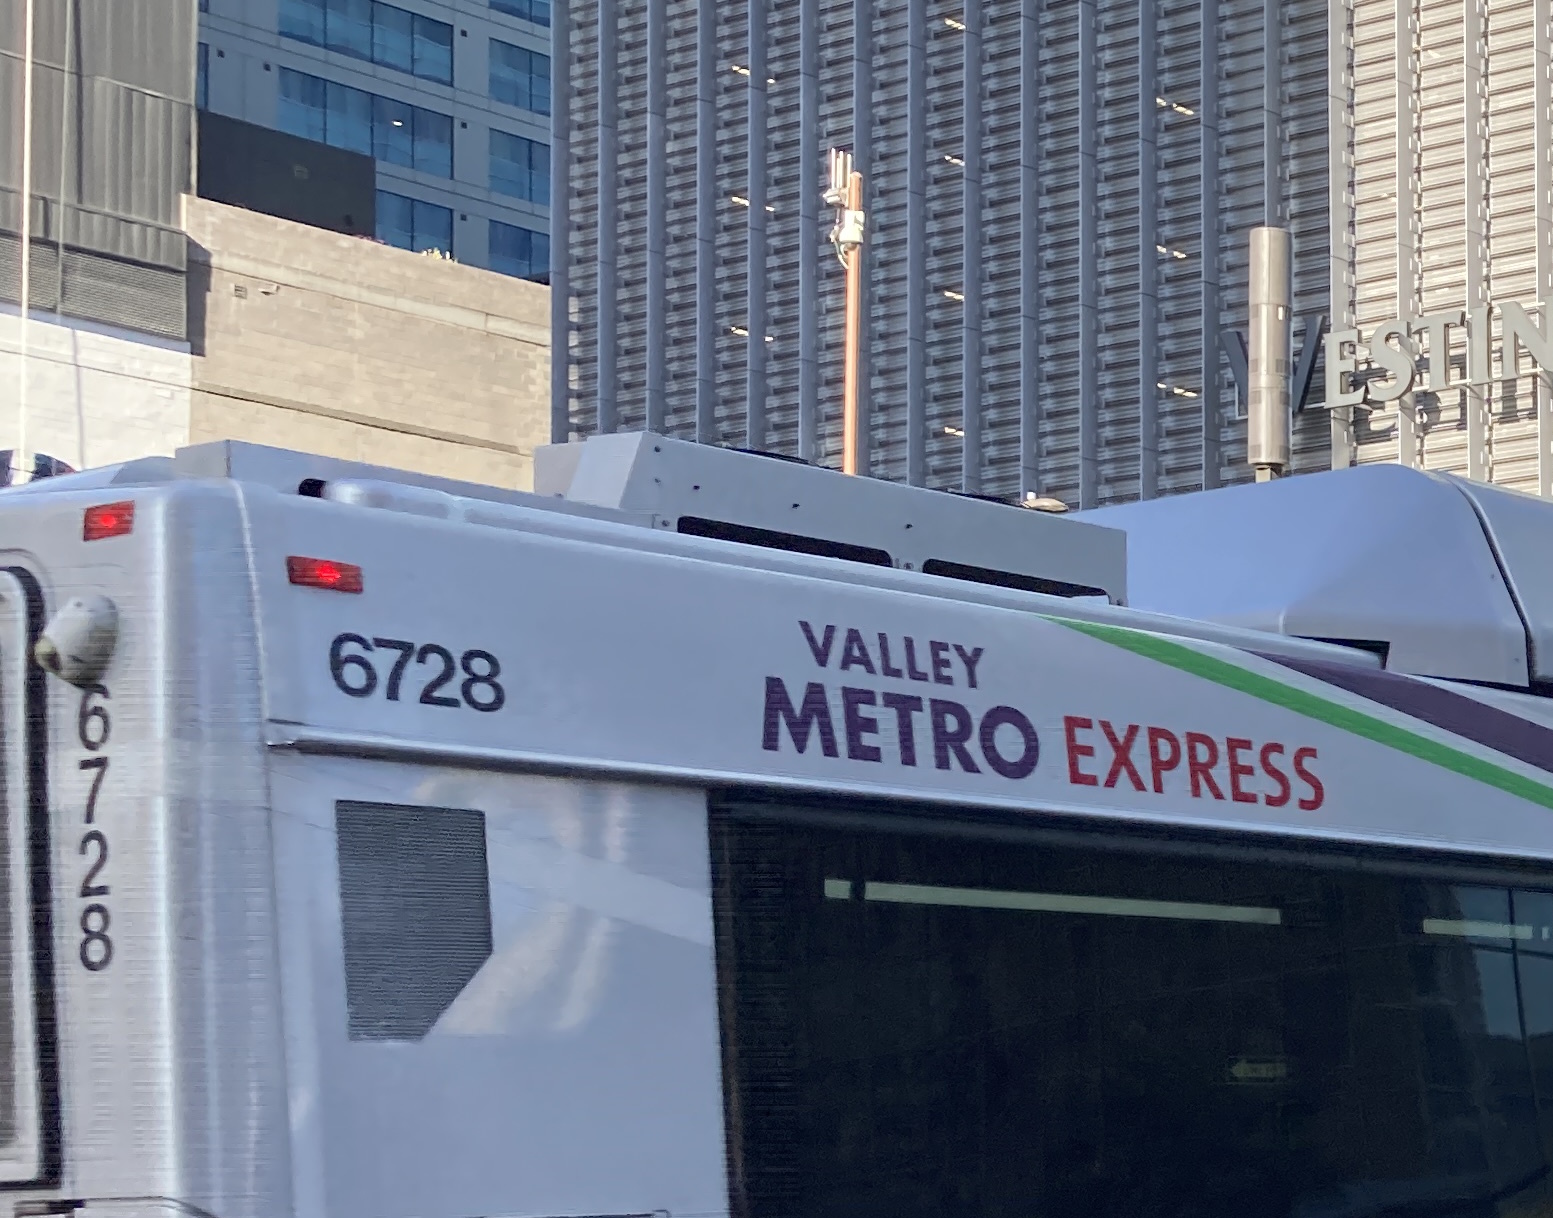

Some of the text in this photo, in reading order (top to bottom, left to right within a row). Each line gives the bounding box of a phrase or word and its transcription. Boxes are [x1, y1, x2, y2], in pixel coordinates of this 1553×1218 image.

[329, 632, 505, 713] 6728
[798, 619, 985, 690] VALLEY
[761, 675, 1325, 812] METRO EXPRESS
[77, 684, 114, 972] 6728
